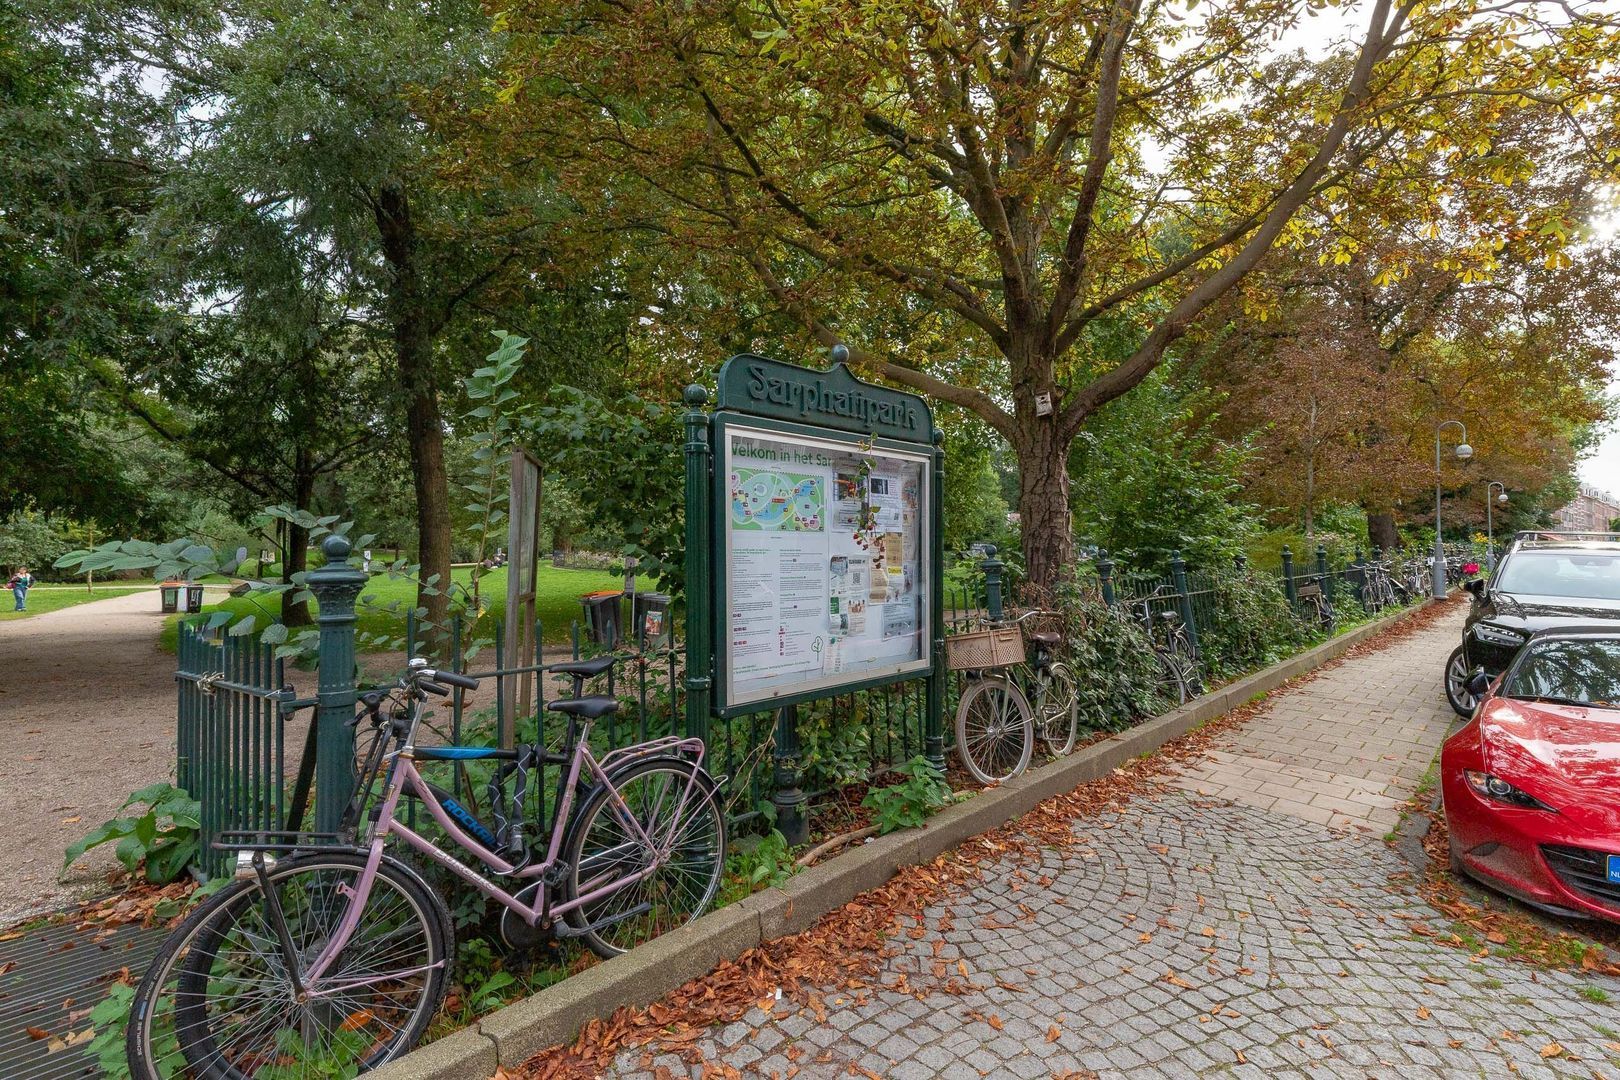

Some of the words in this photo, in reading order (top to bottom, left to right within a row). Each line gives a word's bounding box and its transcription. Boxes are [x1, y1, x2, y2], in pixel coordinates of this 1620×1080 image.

[748, 364, 918, 430] Sarphatipark
[780, 448, 790, 462] in
[794, 449, 813, 464] het
